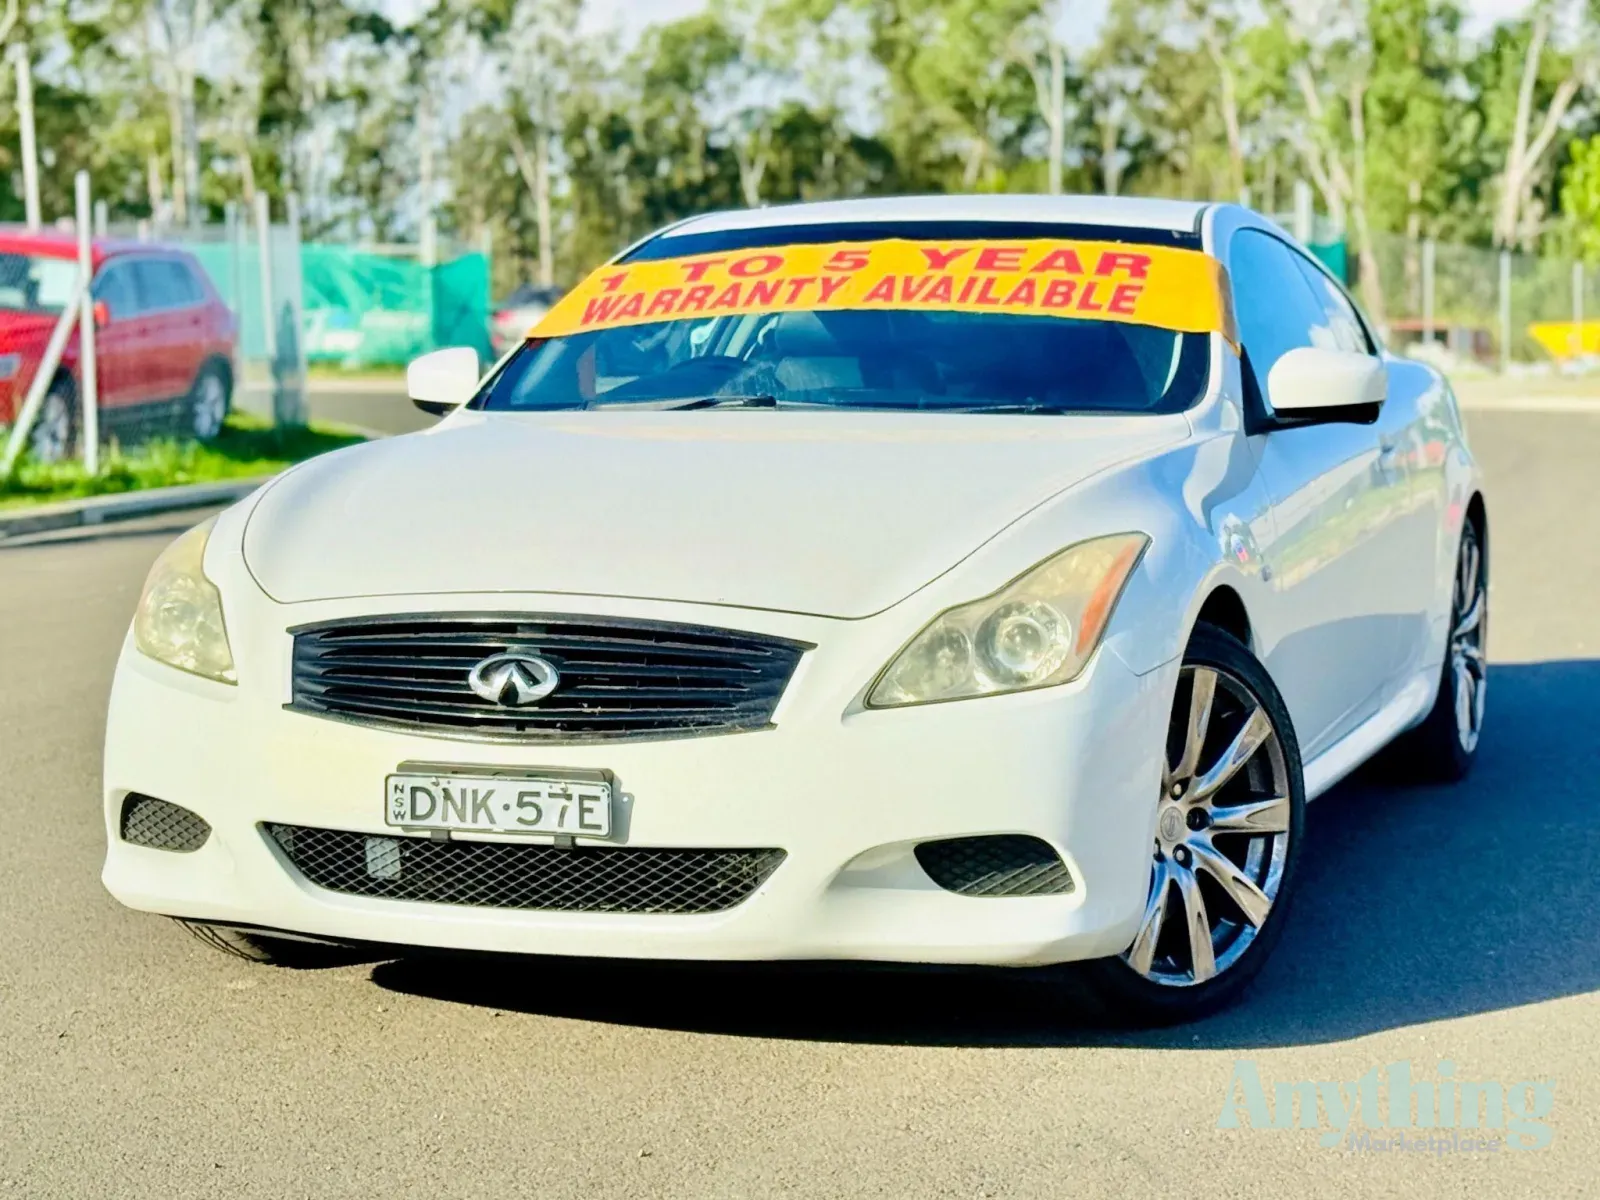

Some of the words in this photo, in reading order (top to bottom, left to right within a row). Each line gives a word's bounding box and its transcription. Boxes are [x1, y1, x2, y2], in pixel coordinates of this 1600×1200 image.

[600, 272, 629, 293] 1
[680, 255, 785, 282] TO
[822, 250, 872, 272] 5
[920, 248, 1153, 279] YEAR
[580, 275, 850, 326] WARRANTY
[862, 275, 1144, 315] AVAILABLE
